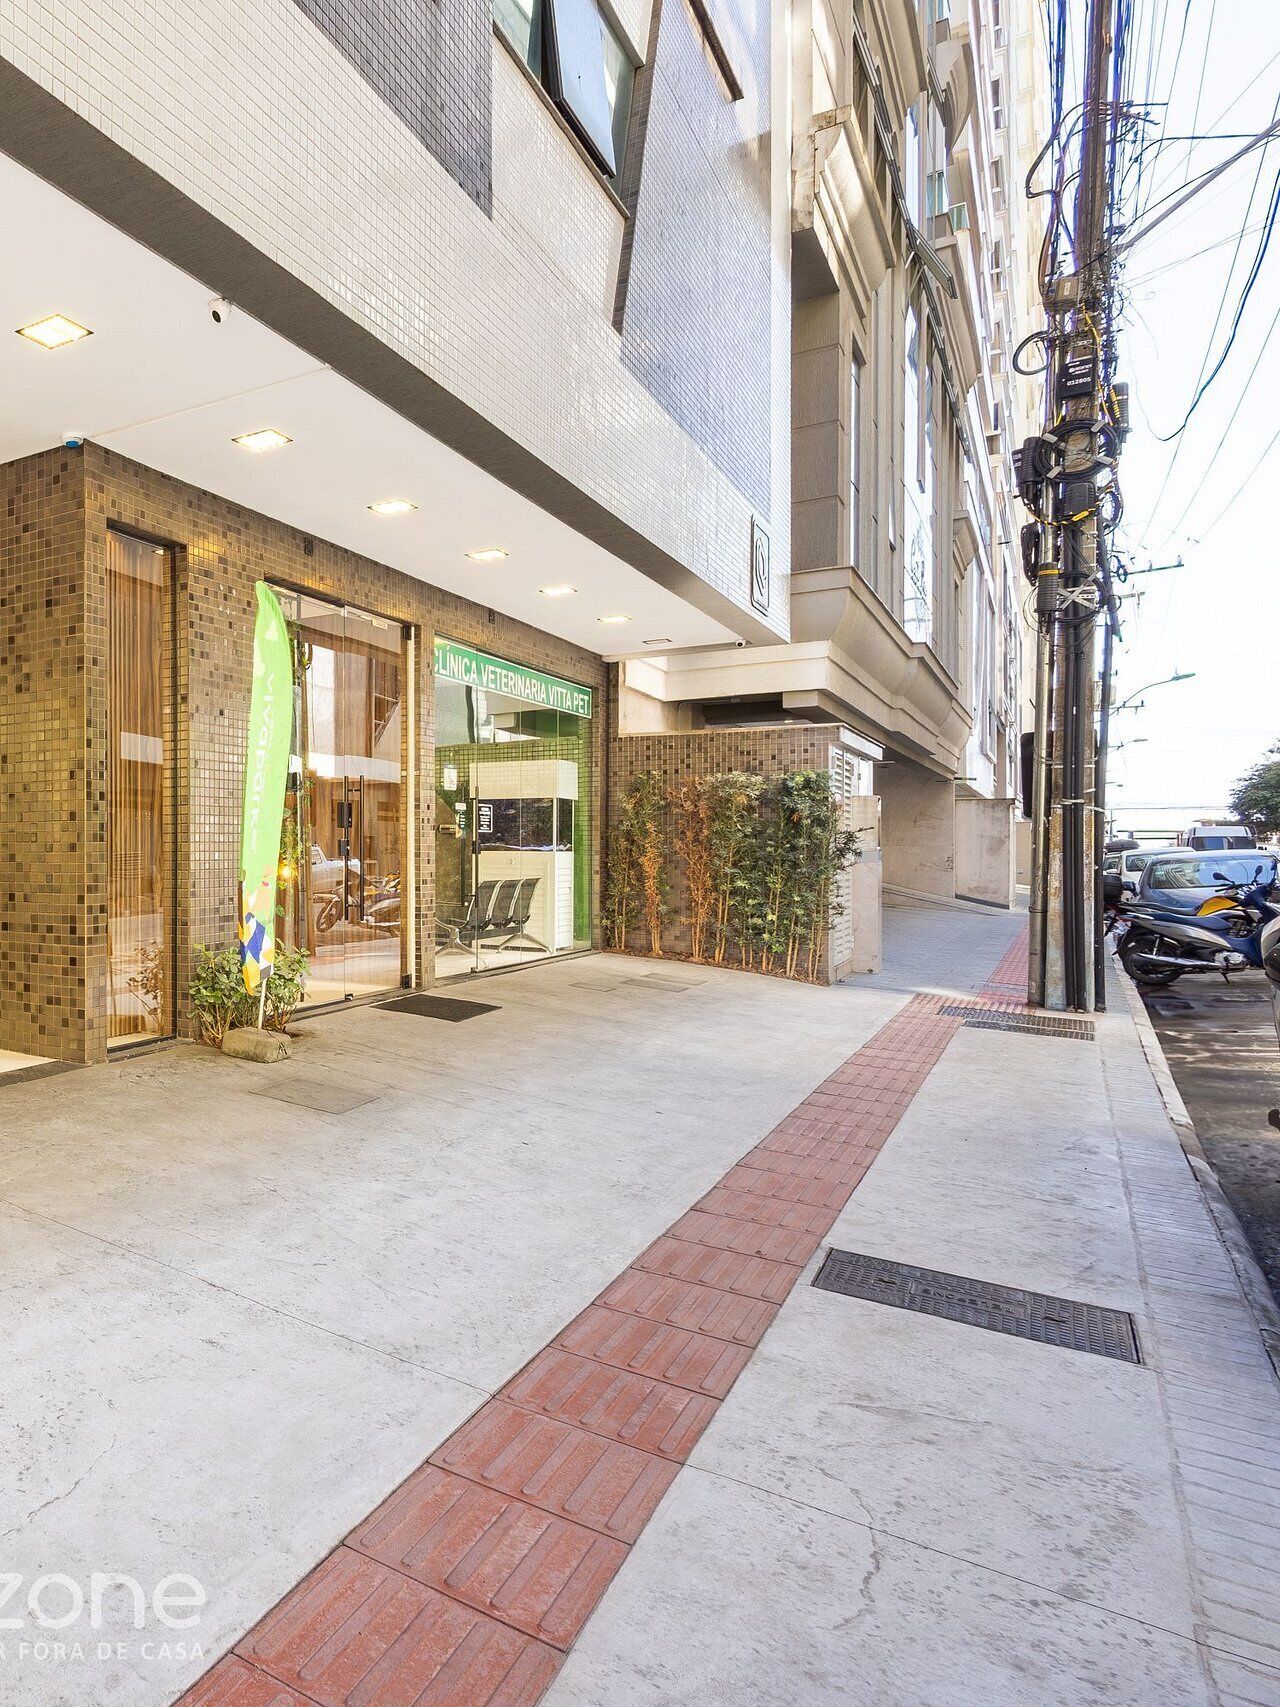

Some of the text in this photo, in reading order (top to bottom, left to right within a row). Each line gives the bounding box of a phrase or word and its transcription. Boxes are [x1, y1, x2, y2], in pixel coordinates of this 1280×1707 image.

[480, 662, 547, 704] VETERINARIA
[548, 684, 572, 711] VITTA
[573, 692, 589, 715] PET
[250, 672, 274, 828] vivapark
